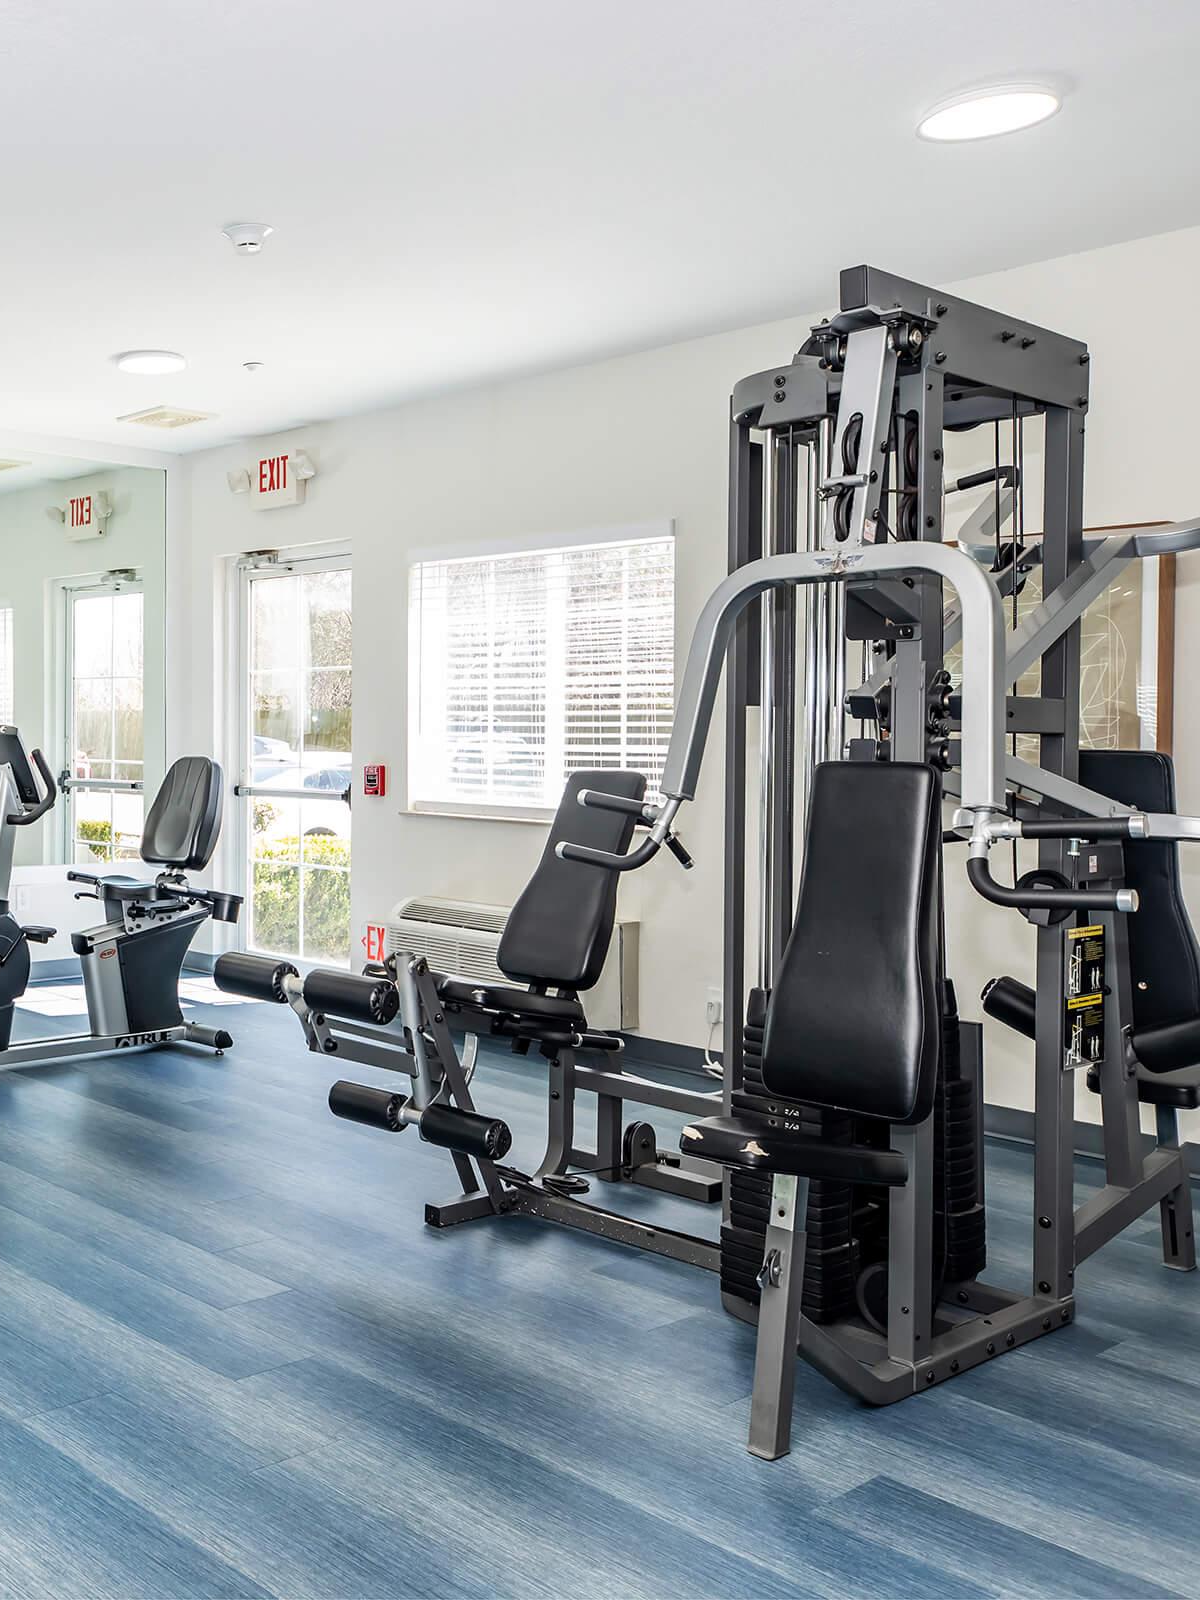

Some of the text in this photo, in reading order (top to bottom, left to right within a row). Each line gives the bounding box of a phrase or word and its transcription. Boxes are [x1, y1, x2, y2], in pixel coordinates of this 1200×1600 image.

[259, 455, 288, 493] EXIT
[367, 926, 385, 961] EX
[131, 1031, 172, 1046] TRUE
